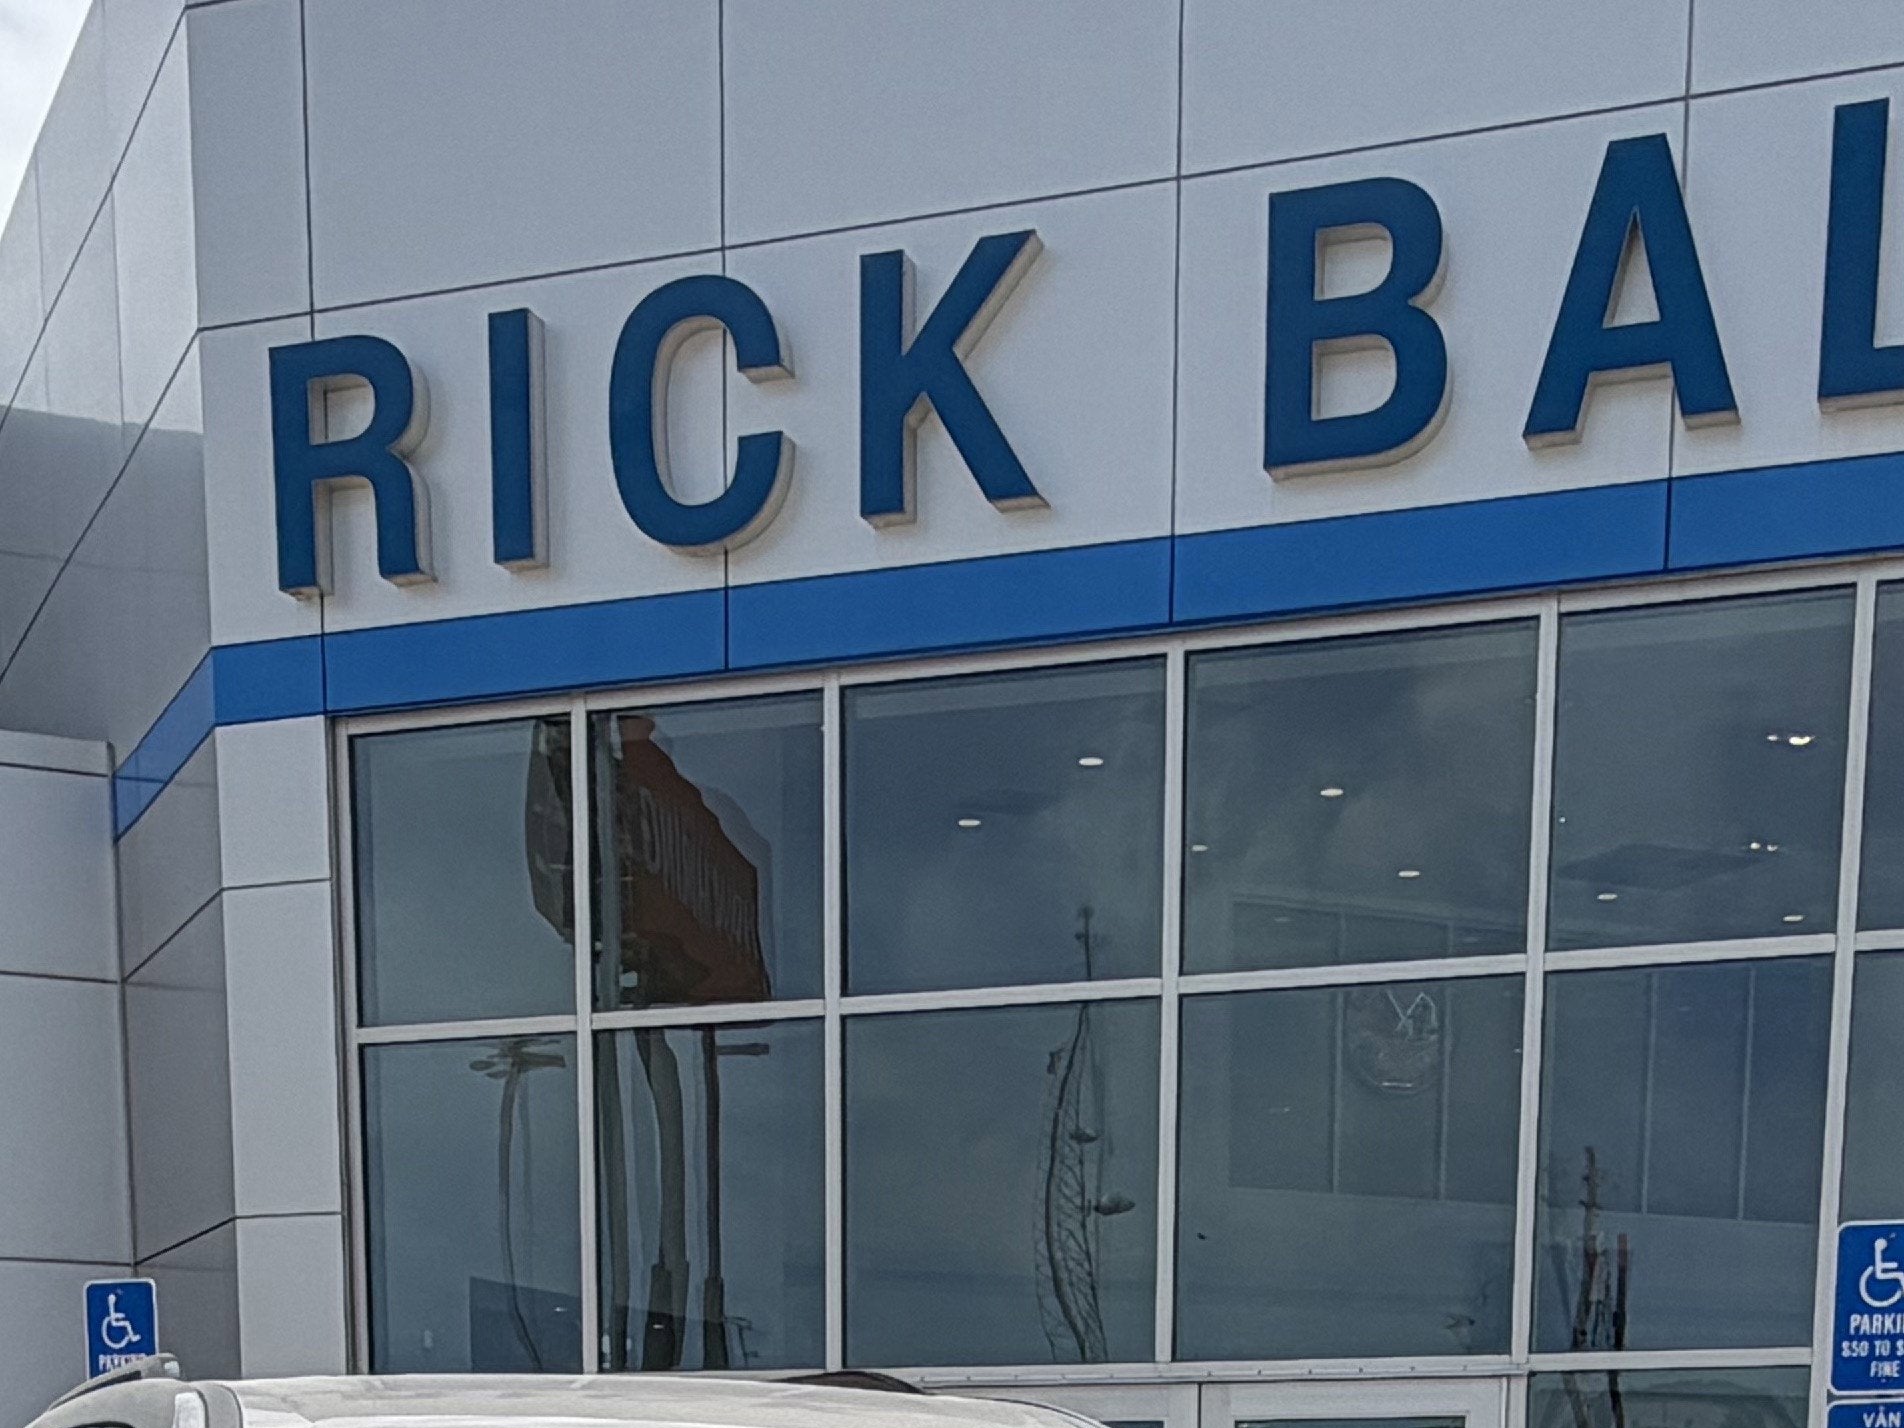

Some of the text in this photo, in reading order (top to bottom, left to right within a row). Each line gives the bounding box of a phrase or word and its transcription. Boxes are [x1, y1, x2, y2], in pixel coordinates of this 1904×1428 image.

[267, 230, 1049, 600] RICK
[1874, 1339, 1892, 1356] TO
[1870, 1360, 1901, 1378] FINE
[1863, 1411, 1902, 1428] VAN
